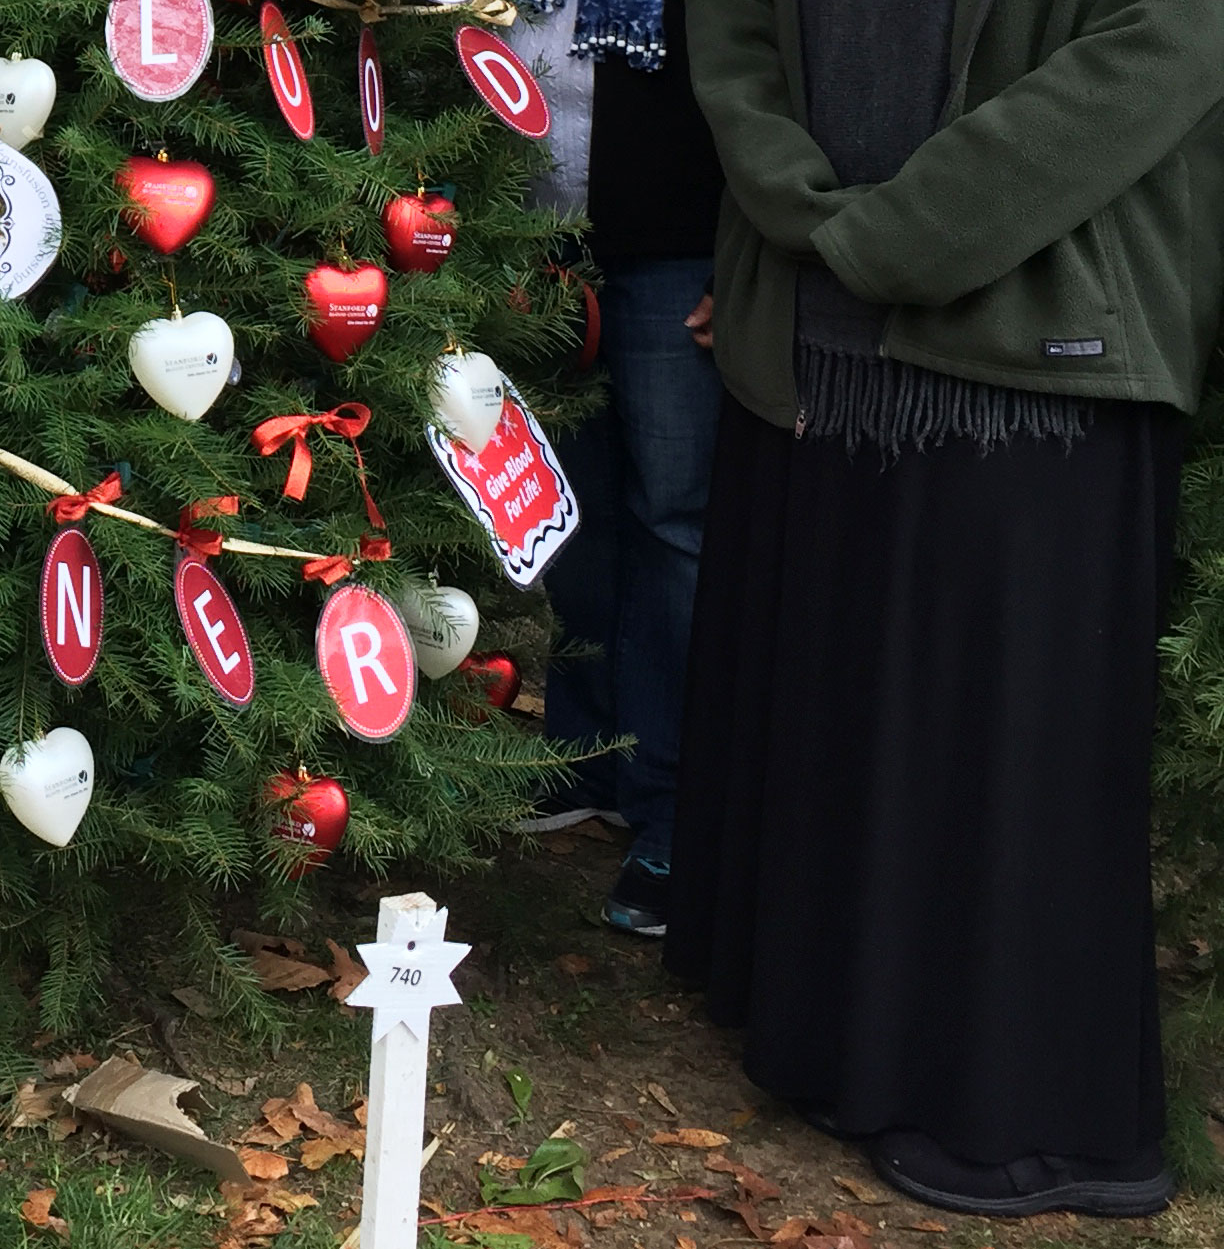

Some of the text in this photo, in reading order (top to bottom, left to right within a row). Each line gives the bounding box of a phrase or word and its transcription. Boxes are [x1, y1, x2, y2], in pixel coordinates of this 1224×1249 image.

[270, 33, 302, 108] O
[472, 50, 530, 116] D
[329, 303, 367, 312] STANFORD
[486, 441, 535, 500] Give Blood
[503, 472, 543, 524] For Life!
[56, 563, 92, 649] N
[193, 590, 242, 675] E
[340, 620, 397, 705] R
[390, 966, 422, 987] 740
